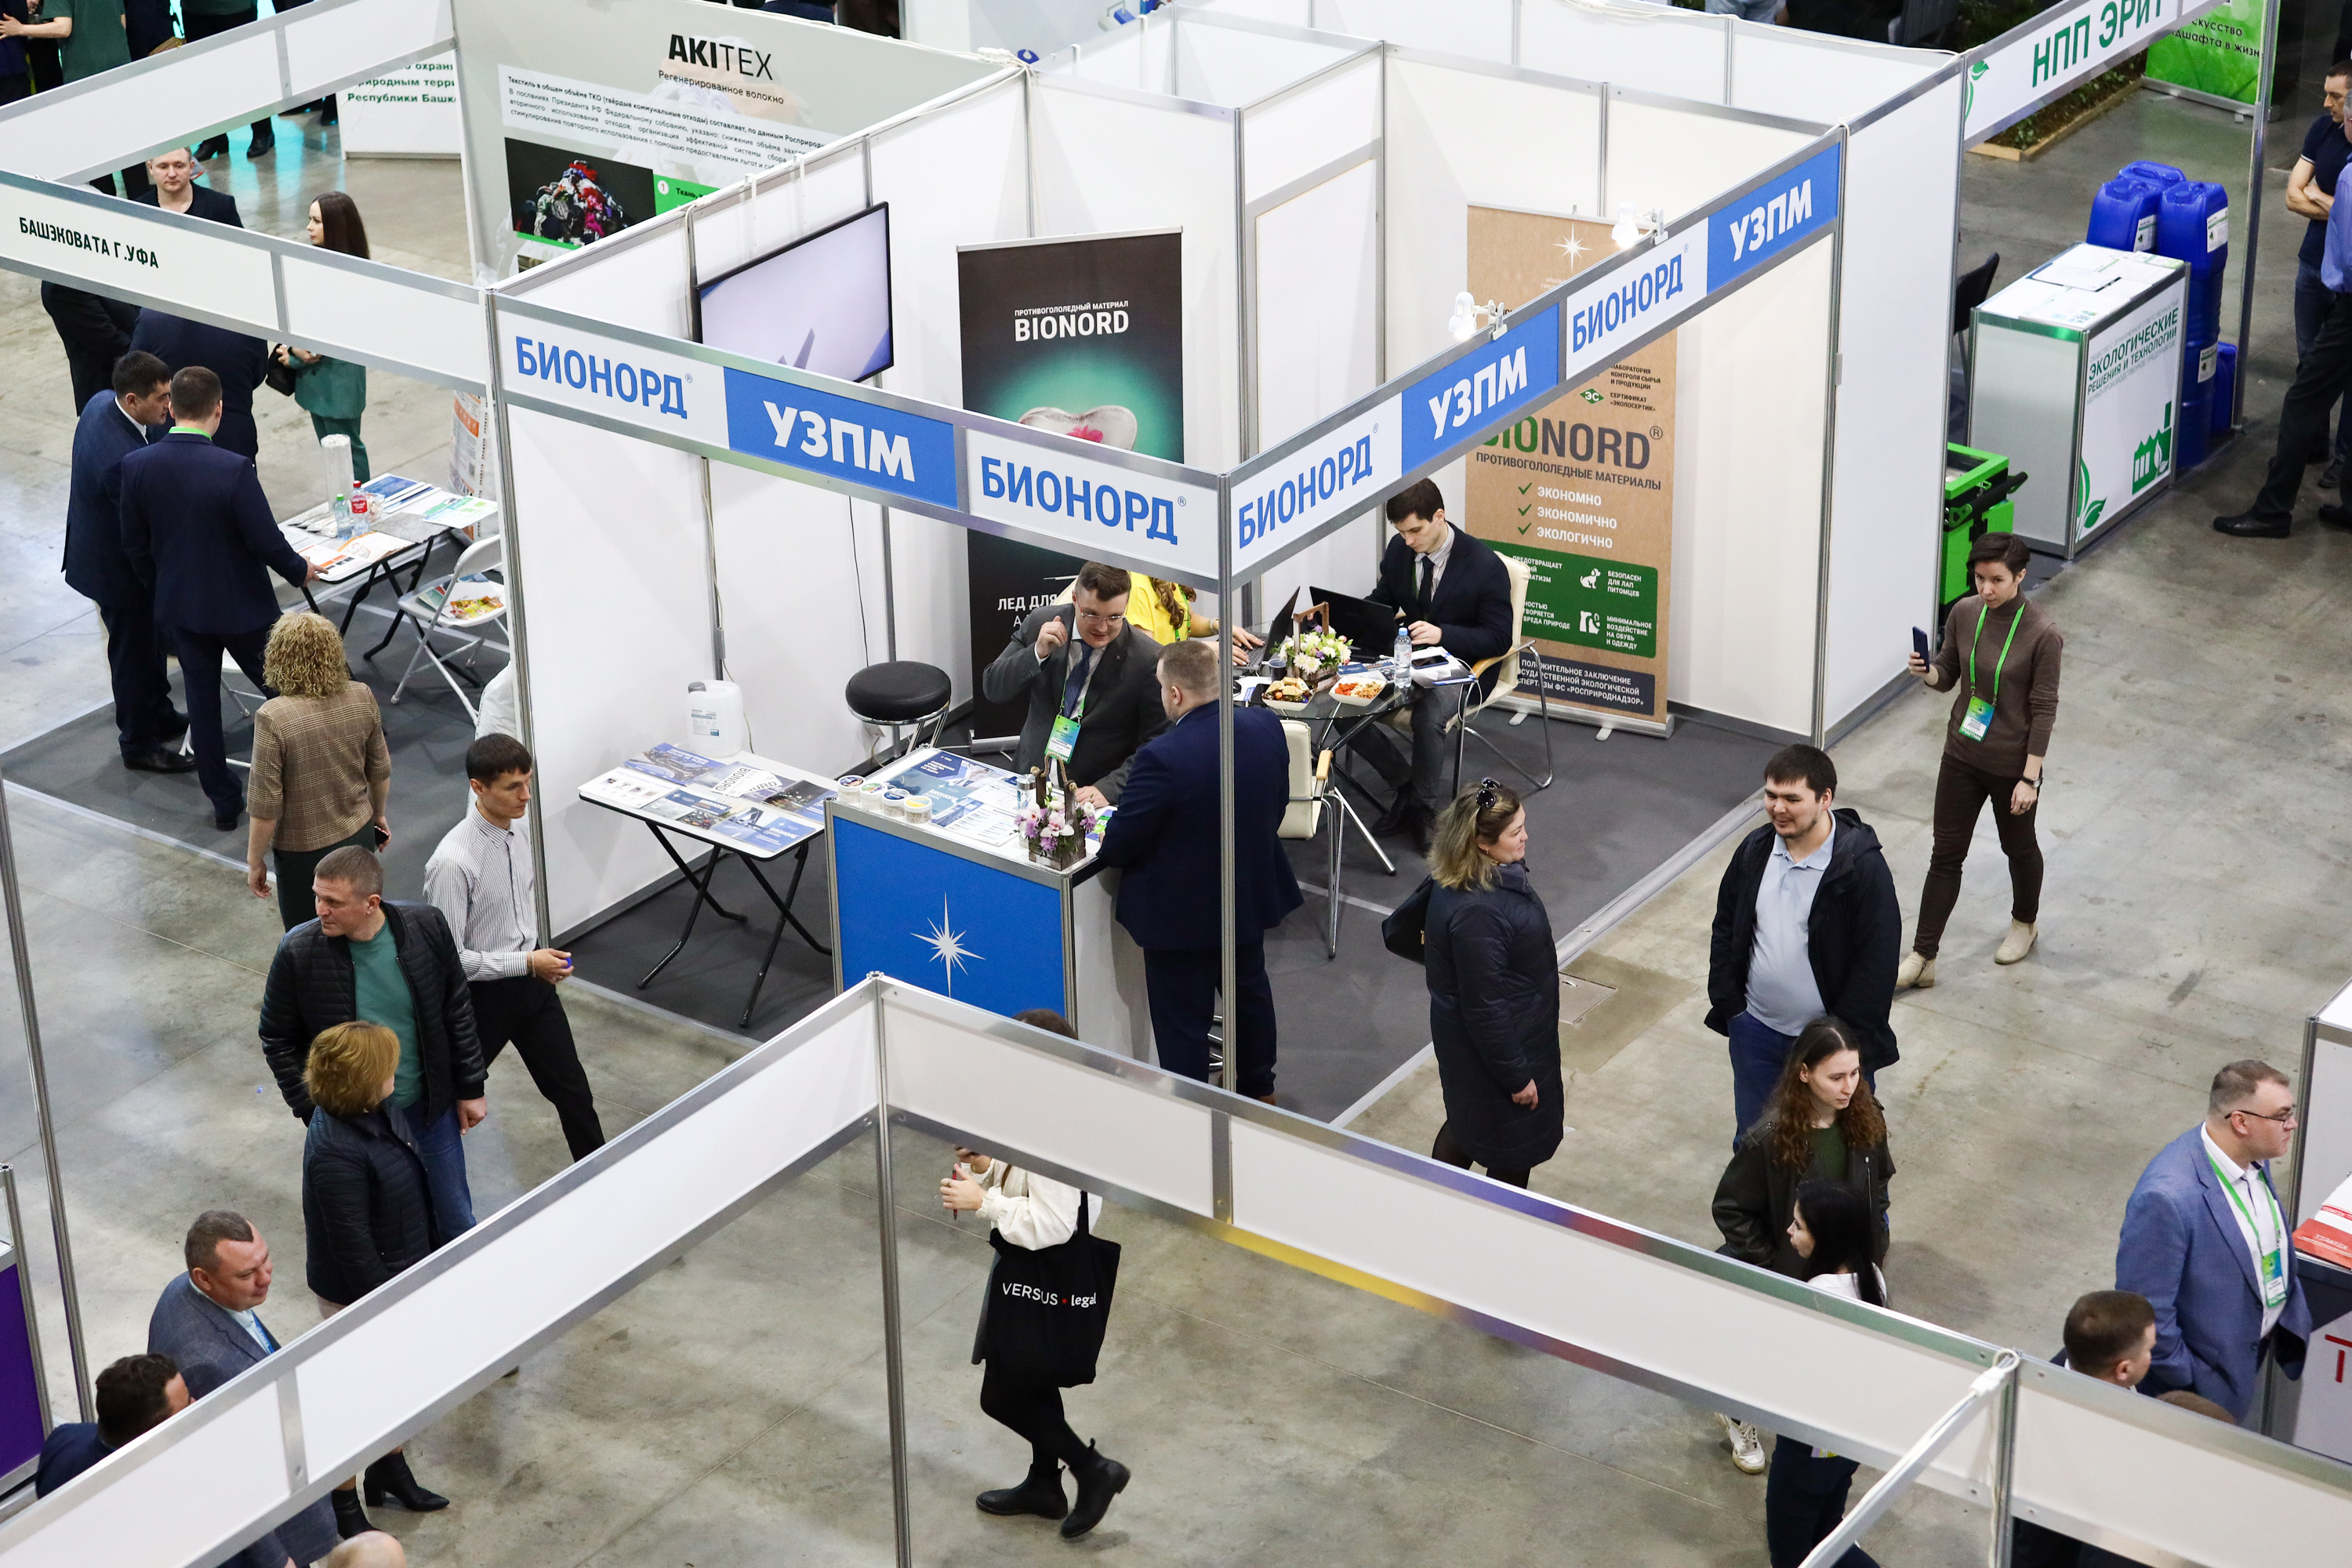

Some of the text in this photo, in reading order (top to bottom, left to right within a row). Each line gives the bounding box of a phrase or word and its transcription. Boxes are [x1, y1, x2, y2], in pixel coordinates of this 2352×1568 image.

[2191, 18, 2243, 37] скусство
[2032, 14, 2091, 88] НПП
[2173, 29, 2222, 48] дшафта
[2234, 43, 2264, 58] жизн
[668, 34, 773, 81] AKITEX
[347, 93, 418, 103] Республики
[659, 70, 784, 104] Регенерированное волокно
[508, 76, 535, 88] Текстиль
[542, 84, 563, 93] общем
[564, 89, 587, 99] объёме
[589, 93, 602, 101] ТКО
[603, 96, 632, 108] (твёрдые
[633, 101, 681, 118] коммунальные
[682, 114, 708, 125] отходы)
[710, 119, 746, 133] составляет,
[757, 129, 783, 140] данным
[510, 99, 546, 111] вторичного
[551, 107, 599, 122] использования
[686, 136, 728, 151] эффективной
[734, 147, 761, 158] системы
[767, 154, 786, 163] сбора
[552, 96, 589, 111] Президента
[604, 107, 652, 125] Федеральному
[691, 126, 719, 139] указано:
[721, 134, 753, 146] снижение
[756, 140, 780, 152] объёма
[510, 109, 562, 125] стимулирование
[563, 120, 599, 133] повторного
[601, 129, 648, 143] использования
[686, 147, 739, 163] предоставления
[740, 158, 757, 167] льгот
[1730, 178, 1813, 262] УЗПМ
[19, 216, 110, 256] БАШЭКОВАТА
[1014, 300, 1128, 317] ПРОТИВОГОЛОЛЕДНЫЙ МАТЕРИАЛ
[1014, 310, 1129, 342] BIONORD
[2089, 307, 2179, 381] ЭКОЛОГИЧЕСКИЕ
[2087, 325, 2177, 396] РЕШЕНИЯ И ТЕХНОЛОГИИ
[1610, 371, 1640, 380] КОНТРОЛЯ
[1616, 379, 1651, 390] ПРОДУКЦИИ
[1428, 345, 1528, 441] УЗПМ
[1584, 391, 1599, 401] ЭС
[1610, 392, 1647, 402] СЕРТИФИКАТ
[763, 400, 916, 482] УЗПМ
[1476, 452, 1661, 491] ПРОТИВОГОЛОЛЕДНЫЕ МАТЕРИАЛЫ
[1537, 486, 1602, 506] ЭКОНОМНО
[1537, 506, 1617, 529] ЭКОНОМИЧНО
[1537, 526, 1613, 549] ЭКОЛОГИЧНО
[1607, 570, 1642, 582] БЕЗОПАСЕН
[1607, 586, 1639, 597] ПИТОМЦЕВ
[997, 597, 1025, 612] ЛЕД
[1524, 601, 1548, 610] НОСТЬЮ
[1543, 619, 1570, 630] ПРИРОДЕ
[1606, 615, 1652, 629] МИНИМАЛЬНОЕ
[1606, 623, 1648, 636] ВОЗДЕЙСТВИЕ
[1611, 640, 1637, 650] ОДЕЖДУ
[1616, 633, 1635, 641] ОБУВЬ
[1522, 659, 1631, 685] ПОЛЖИТЕЛЬНОЕ ЗАКЛЮЧЕНИЕ
[1566, 686, 1644, 706] «РОСПРИРОДНАДЗОР»
[1581, 679, 1639, 696] ЭКОЛОГИЧЕСКОЙ
[715, 768, 751, 791] BIONORD
[1002, 1283, 1097, 1308] VERSUS legal
